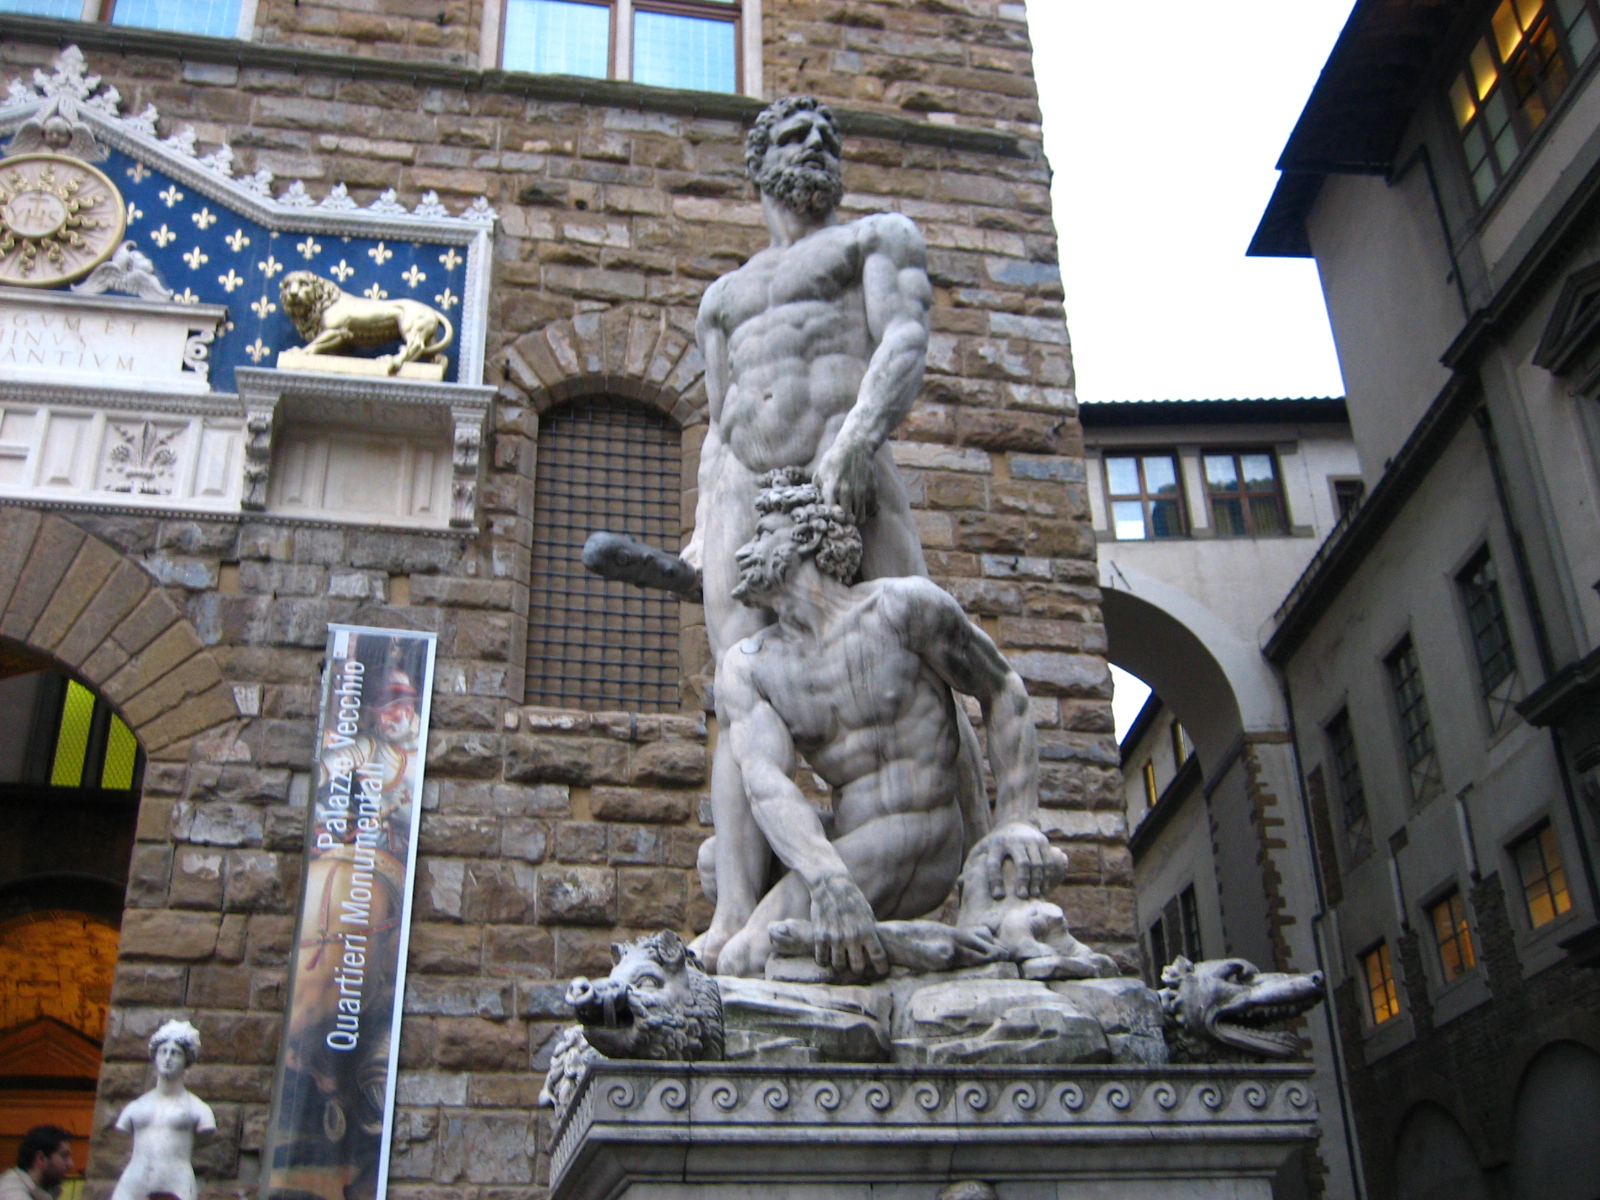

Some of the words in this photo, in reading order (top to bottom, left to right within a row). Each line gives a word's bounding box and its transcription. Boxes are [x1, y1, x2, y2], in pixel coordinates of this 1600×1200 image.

[327, 660, 366, 750] Vecchio
[317, 756, 354, 851] Palazzo
[339, 762, 385, 926] Monumentali
[326, 932, 368, 1051] Quartieri
